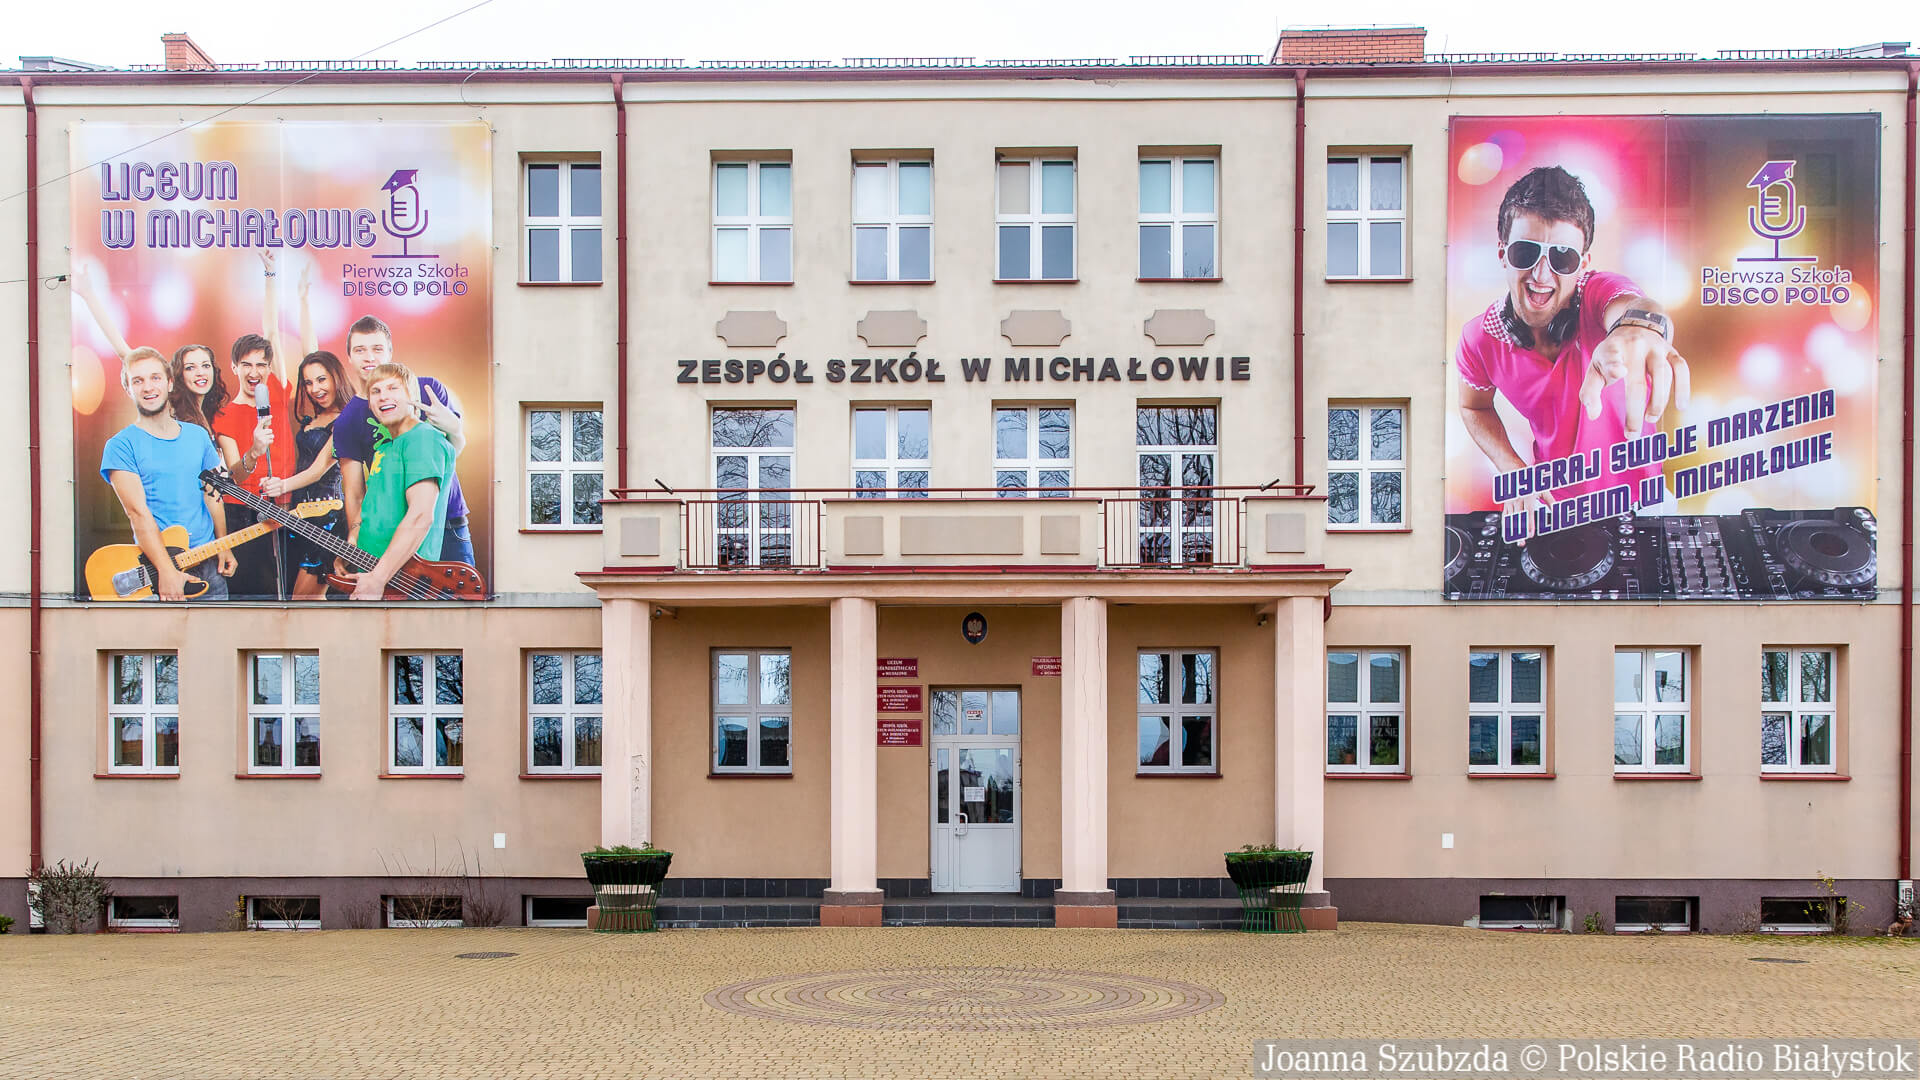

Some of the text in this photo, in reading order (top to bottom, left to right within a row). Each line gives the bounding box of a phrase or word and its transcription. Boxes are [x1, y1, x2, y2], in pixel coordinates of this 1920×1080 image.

[100, 161, 239, 202] LICEUM
[100, 208, 378, 249] W MICHAŁOWIE
[342, 262, 469, 278] Pierwsza Szkoła
[1702, 266, 1851, 284] Pierwsza Szkoła
[343, 280, 468, 296] DISCO POLO
[1702, 286, 1850, 304] DISCO POLO
[677, 351, 1251, 384] ZESPÓŁ SZKÓŁ W MICHAŁOWIE
[1494, 389, 1836, 502] WYGRAJ SWOJE MARZENIA
[1504, 432, 1833, 543] W LICEUM W MICHAŁOWIE
